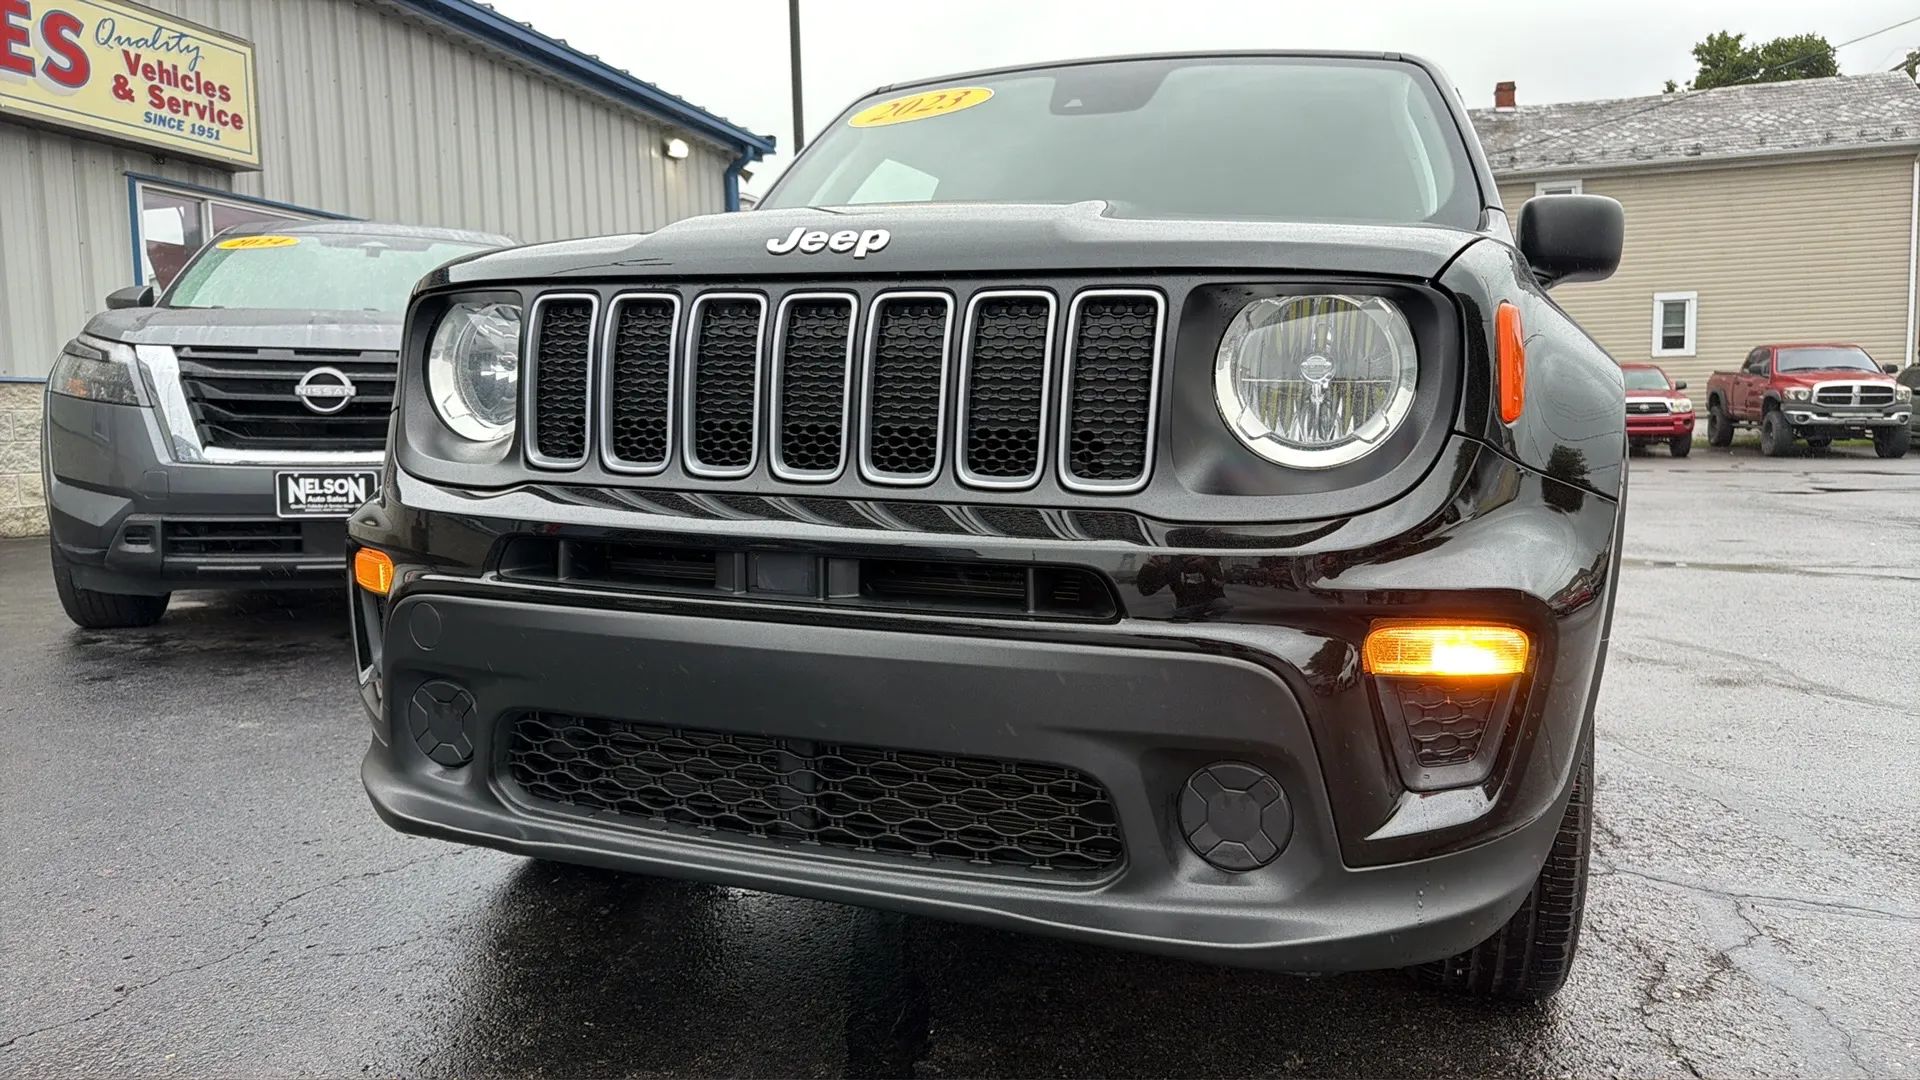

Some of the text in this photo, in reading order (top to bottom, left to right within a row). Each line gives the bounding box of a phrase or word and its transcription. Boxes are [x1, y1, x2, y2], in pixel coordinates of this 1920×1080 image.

[95, 17, 205, 72] Quality
[121, 49, 232, 103] Vehicles
[112, 73, 245, 131] & Service
[866, 90, 972, 123] 2023
[143, 111, 221, 141] SINCE 1951
[766, 226, 891, 259] Jeep
[297, 386, 354, 396] NISSAN
[287, 475, 367, 505] NELSON
[307, 494, 348, 503] Auto Sales
